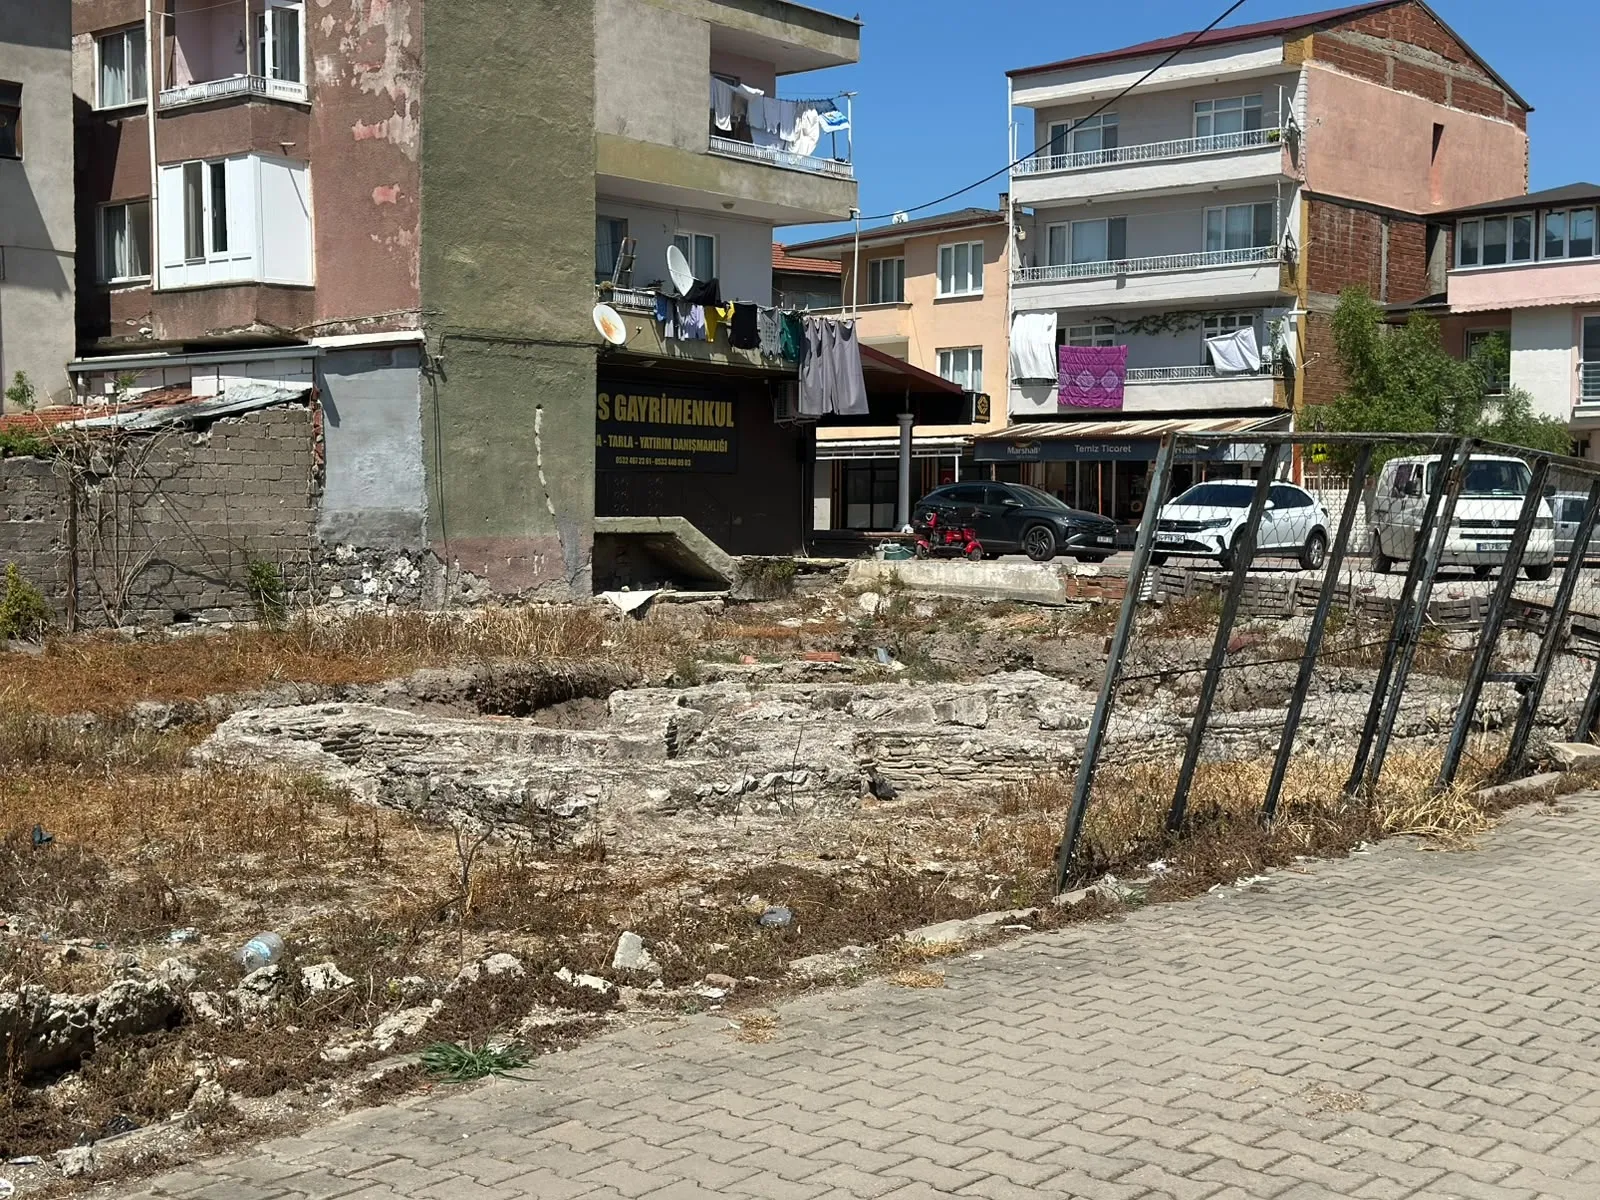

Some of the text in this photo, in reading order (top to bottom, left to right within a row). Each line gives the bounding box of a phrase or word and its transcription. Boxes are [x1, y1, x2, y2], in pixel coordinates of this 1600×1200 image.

[614, 393, 735, 427] GAYRİMENKUL
[608, 434, 634, 449] TARLA
[640, 436, 672, 450] YATIRIM
[673, 438, 728, 454] DANIŞMANLIĞI
[1074, 444, 1099, 453] Temiz
